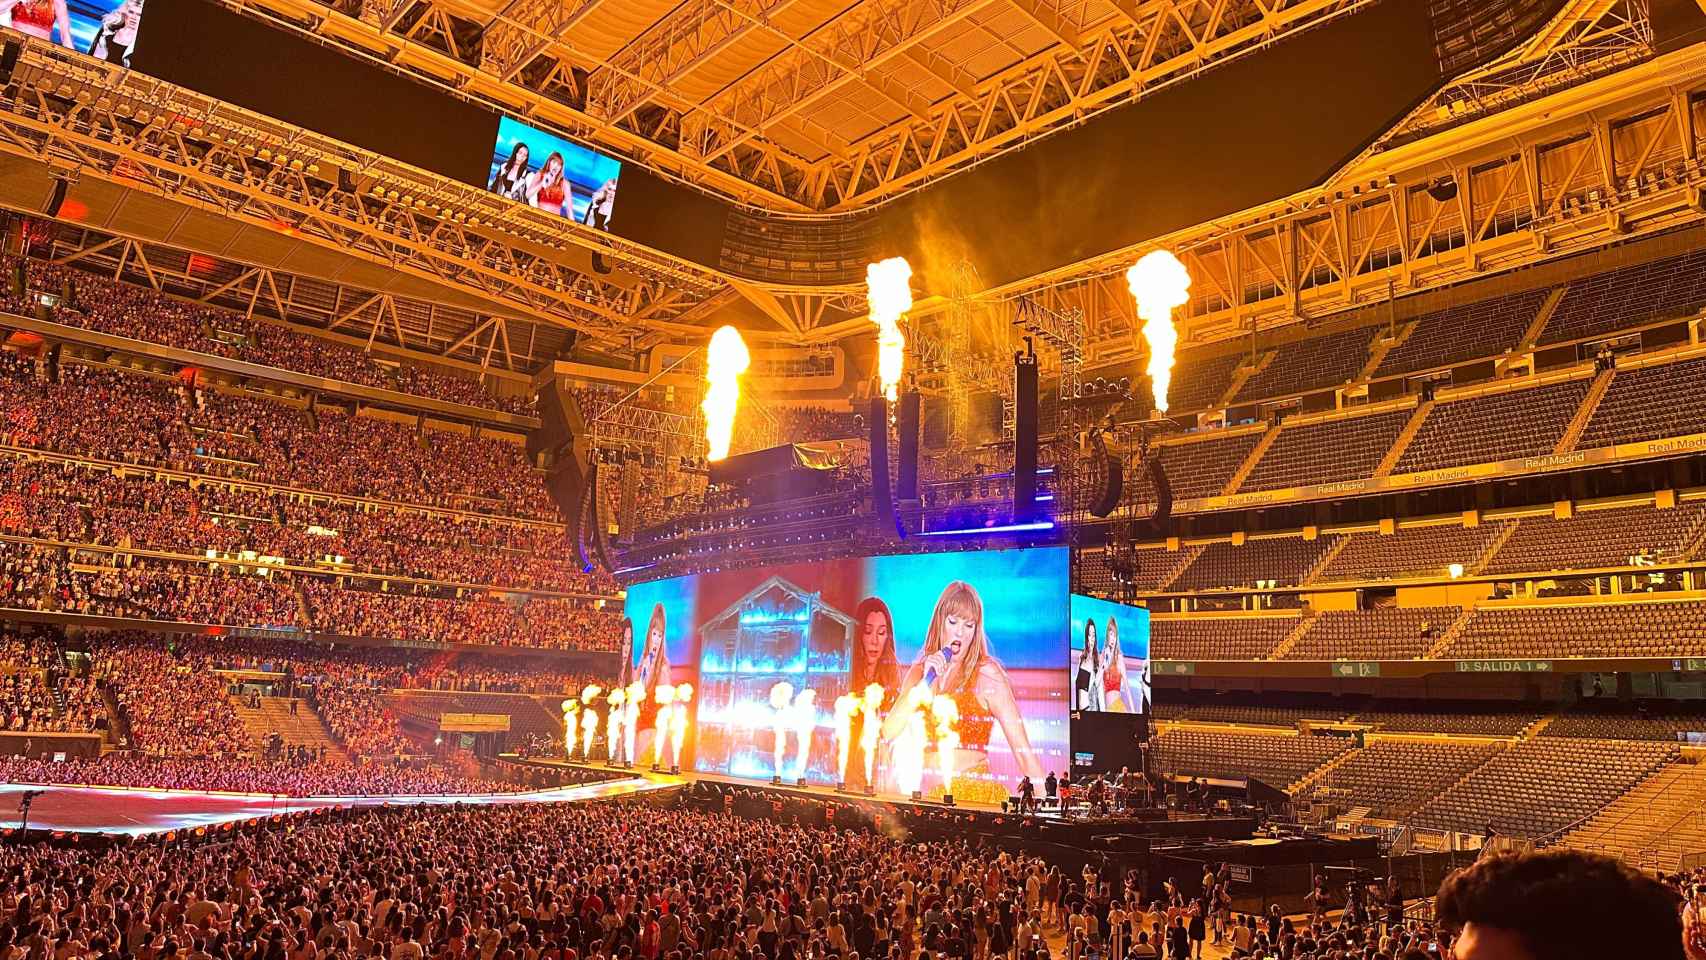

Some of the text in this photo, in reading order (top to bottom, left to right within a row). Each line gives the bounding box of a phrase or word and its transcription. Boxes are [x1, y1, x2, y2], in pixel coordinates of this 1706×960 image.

[1648, 441, 1673, 453] Real
[1525, 451, 1585, 469] Real Madrid
[1439, 470, 1470, 481] Madrid
[1337, 481, 1365, 492] Madrid
[1474, 661, 1521, 672] SALIDA
